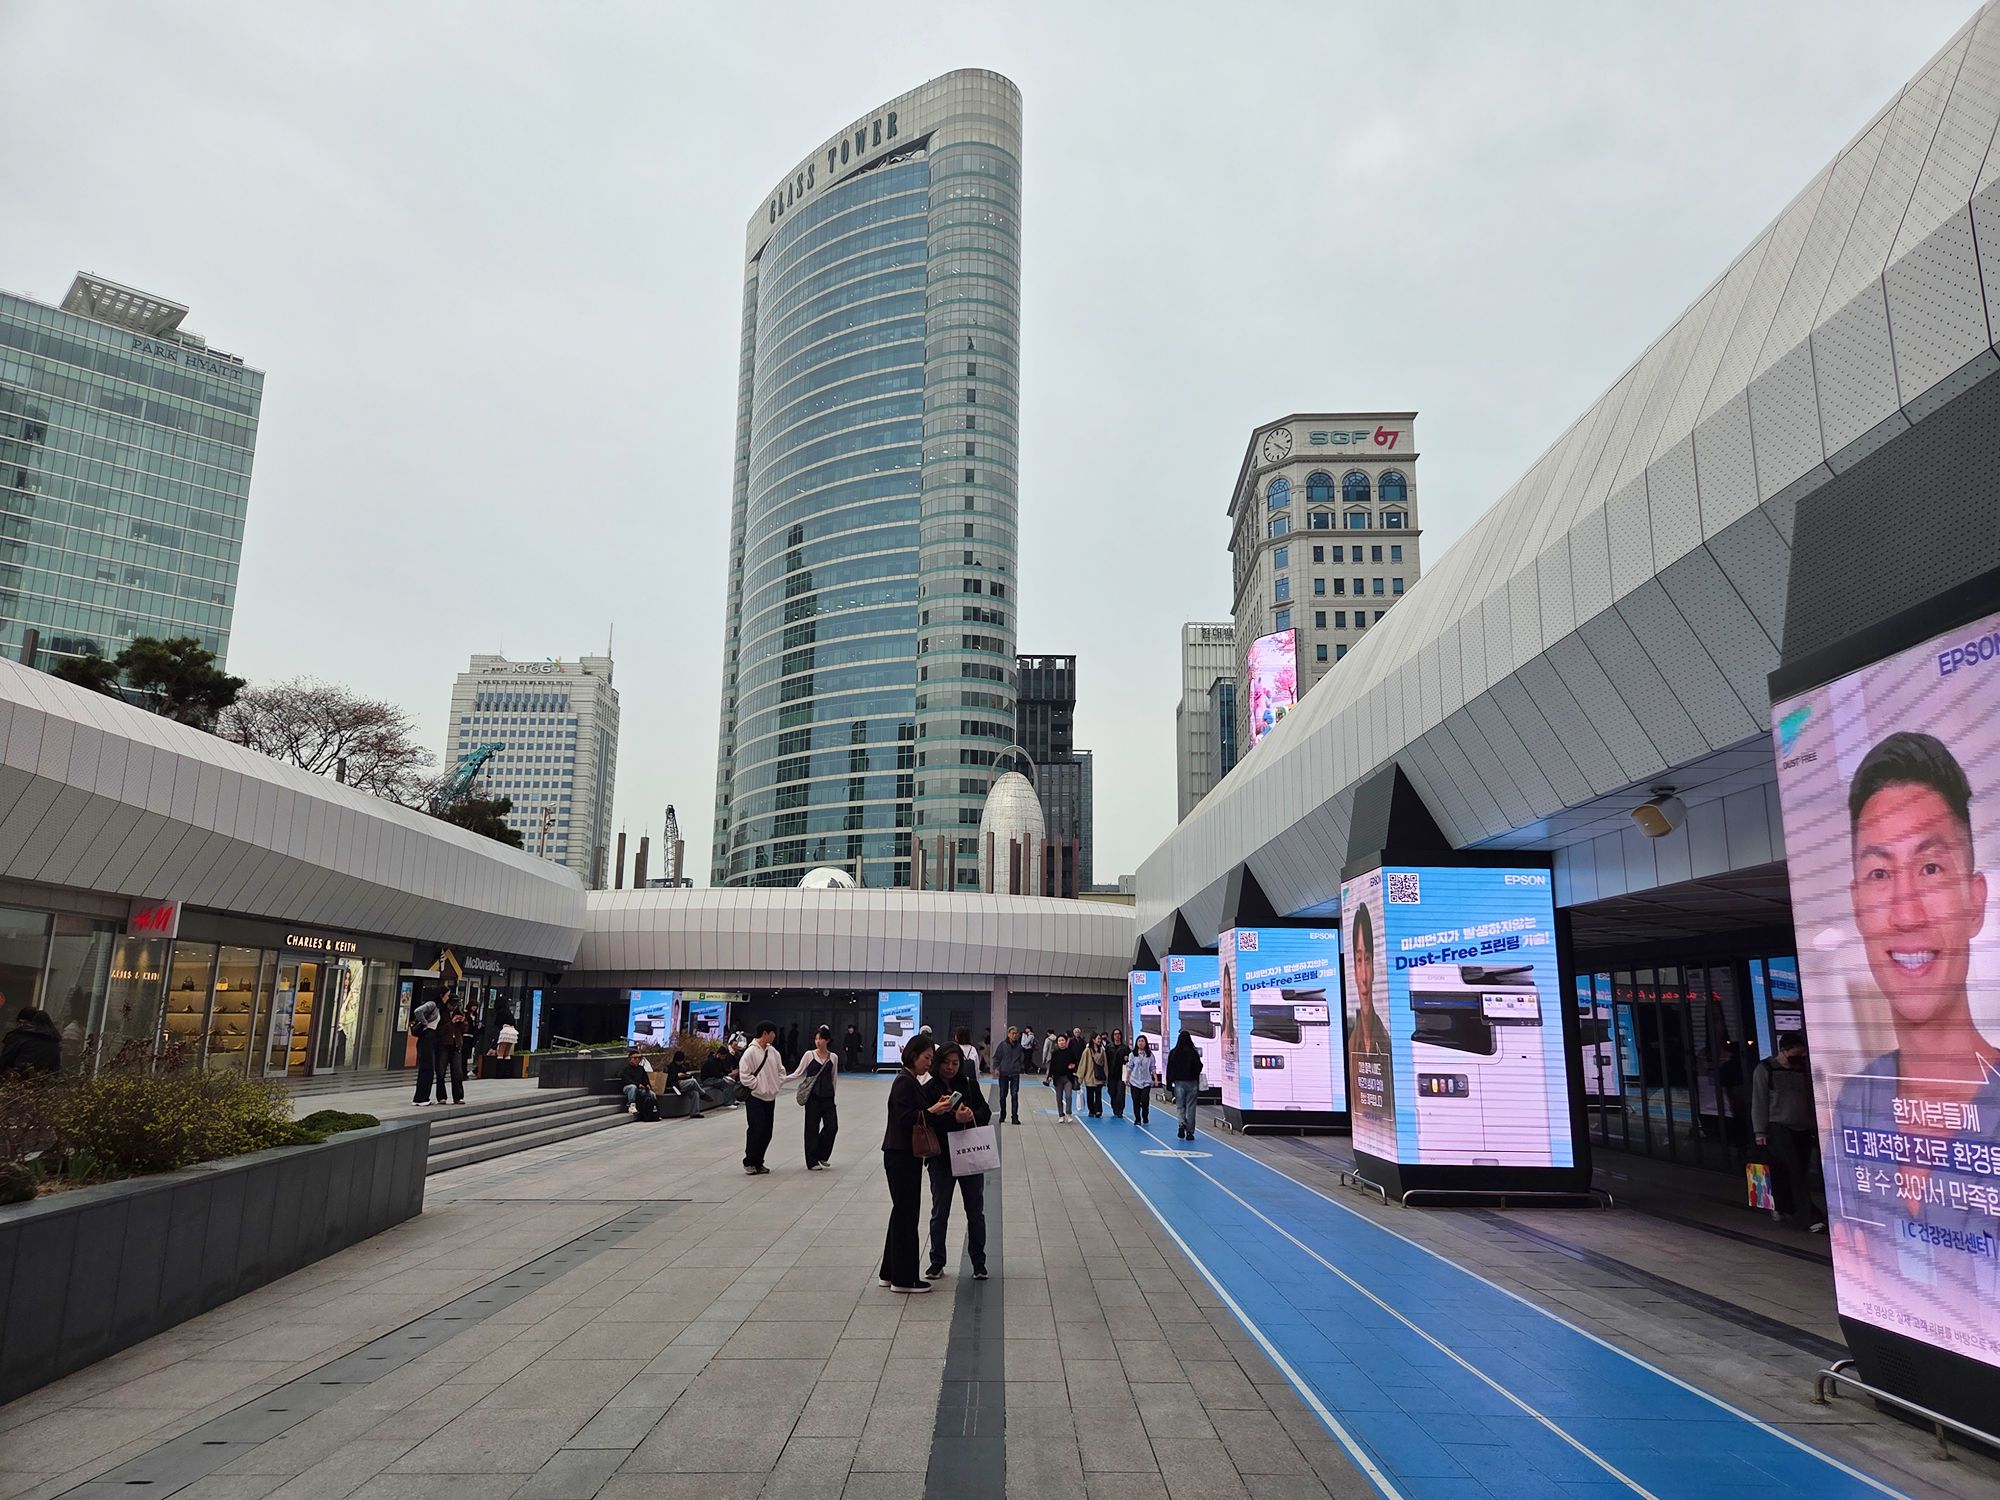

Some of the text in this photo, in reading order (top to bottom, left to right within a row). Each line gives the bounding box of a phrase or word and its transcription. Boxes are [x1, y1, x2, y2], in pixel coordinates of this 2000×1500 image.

[769, 111, 898, 225] GLASS TOWER
[132, 338, 242, 380] PARK HYATT
[1309, 425, 1400, 450] SGF 67
[512, 662, 552, 674] KT&G
[1504, 874, 1546, 886] EPSON
[286, 934, 357, 953] CHARLES & KEITH
[1310, 932, 1335, 940] EPSON
[1400, 916, 1537, 951] 미세먼지가 발생하지않는
[464, 955, 501, 972] McDonald's
[1395, 931, 1550, 971] Dust-Free 프린팅 기술!
[1172, 990, 1210, 1002] Dust-Free
[1242, 977, 1293, 992] Dust-Free
[1892, 1097, 1981, 1133] 환자분들께
[1843, 1129, 1860, 1156] 더
[1862, 1131, 1911, 1163] 쾌적한
[1913, 1138, 1950, 1168] 진료
[1854, 1165, 2000, 1217] 할 수 있어서 만족합
[1917, 1222, 1989, 1257] 건강검진센터
